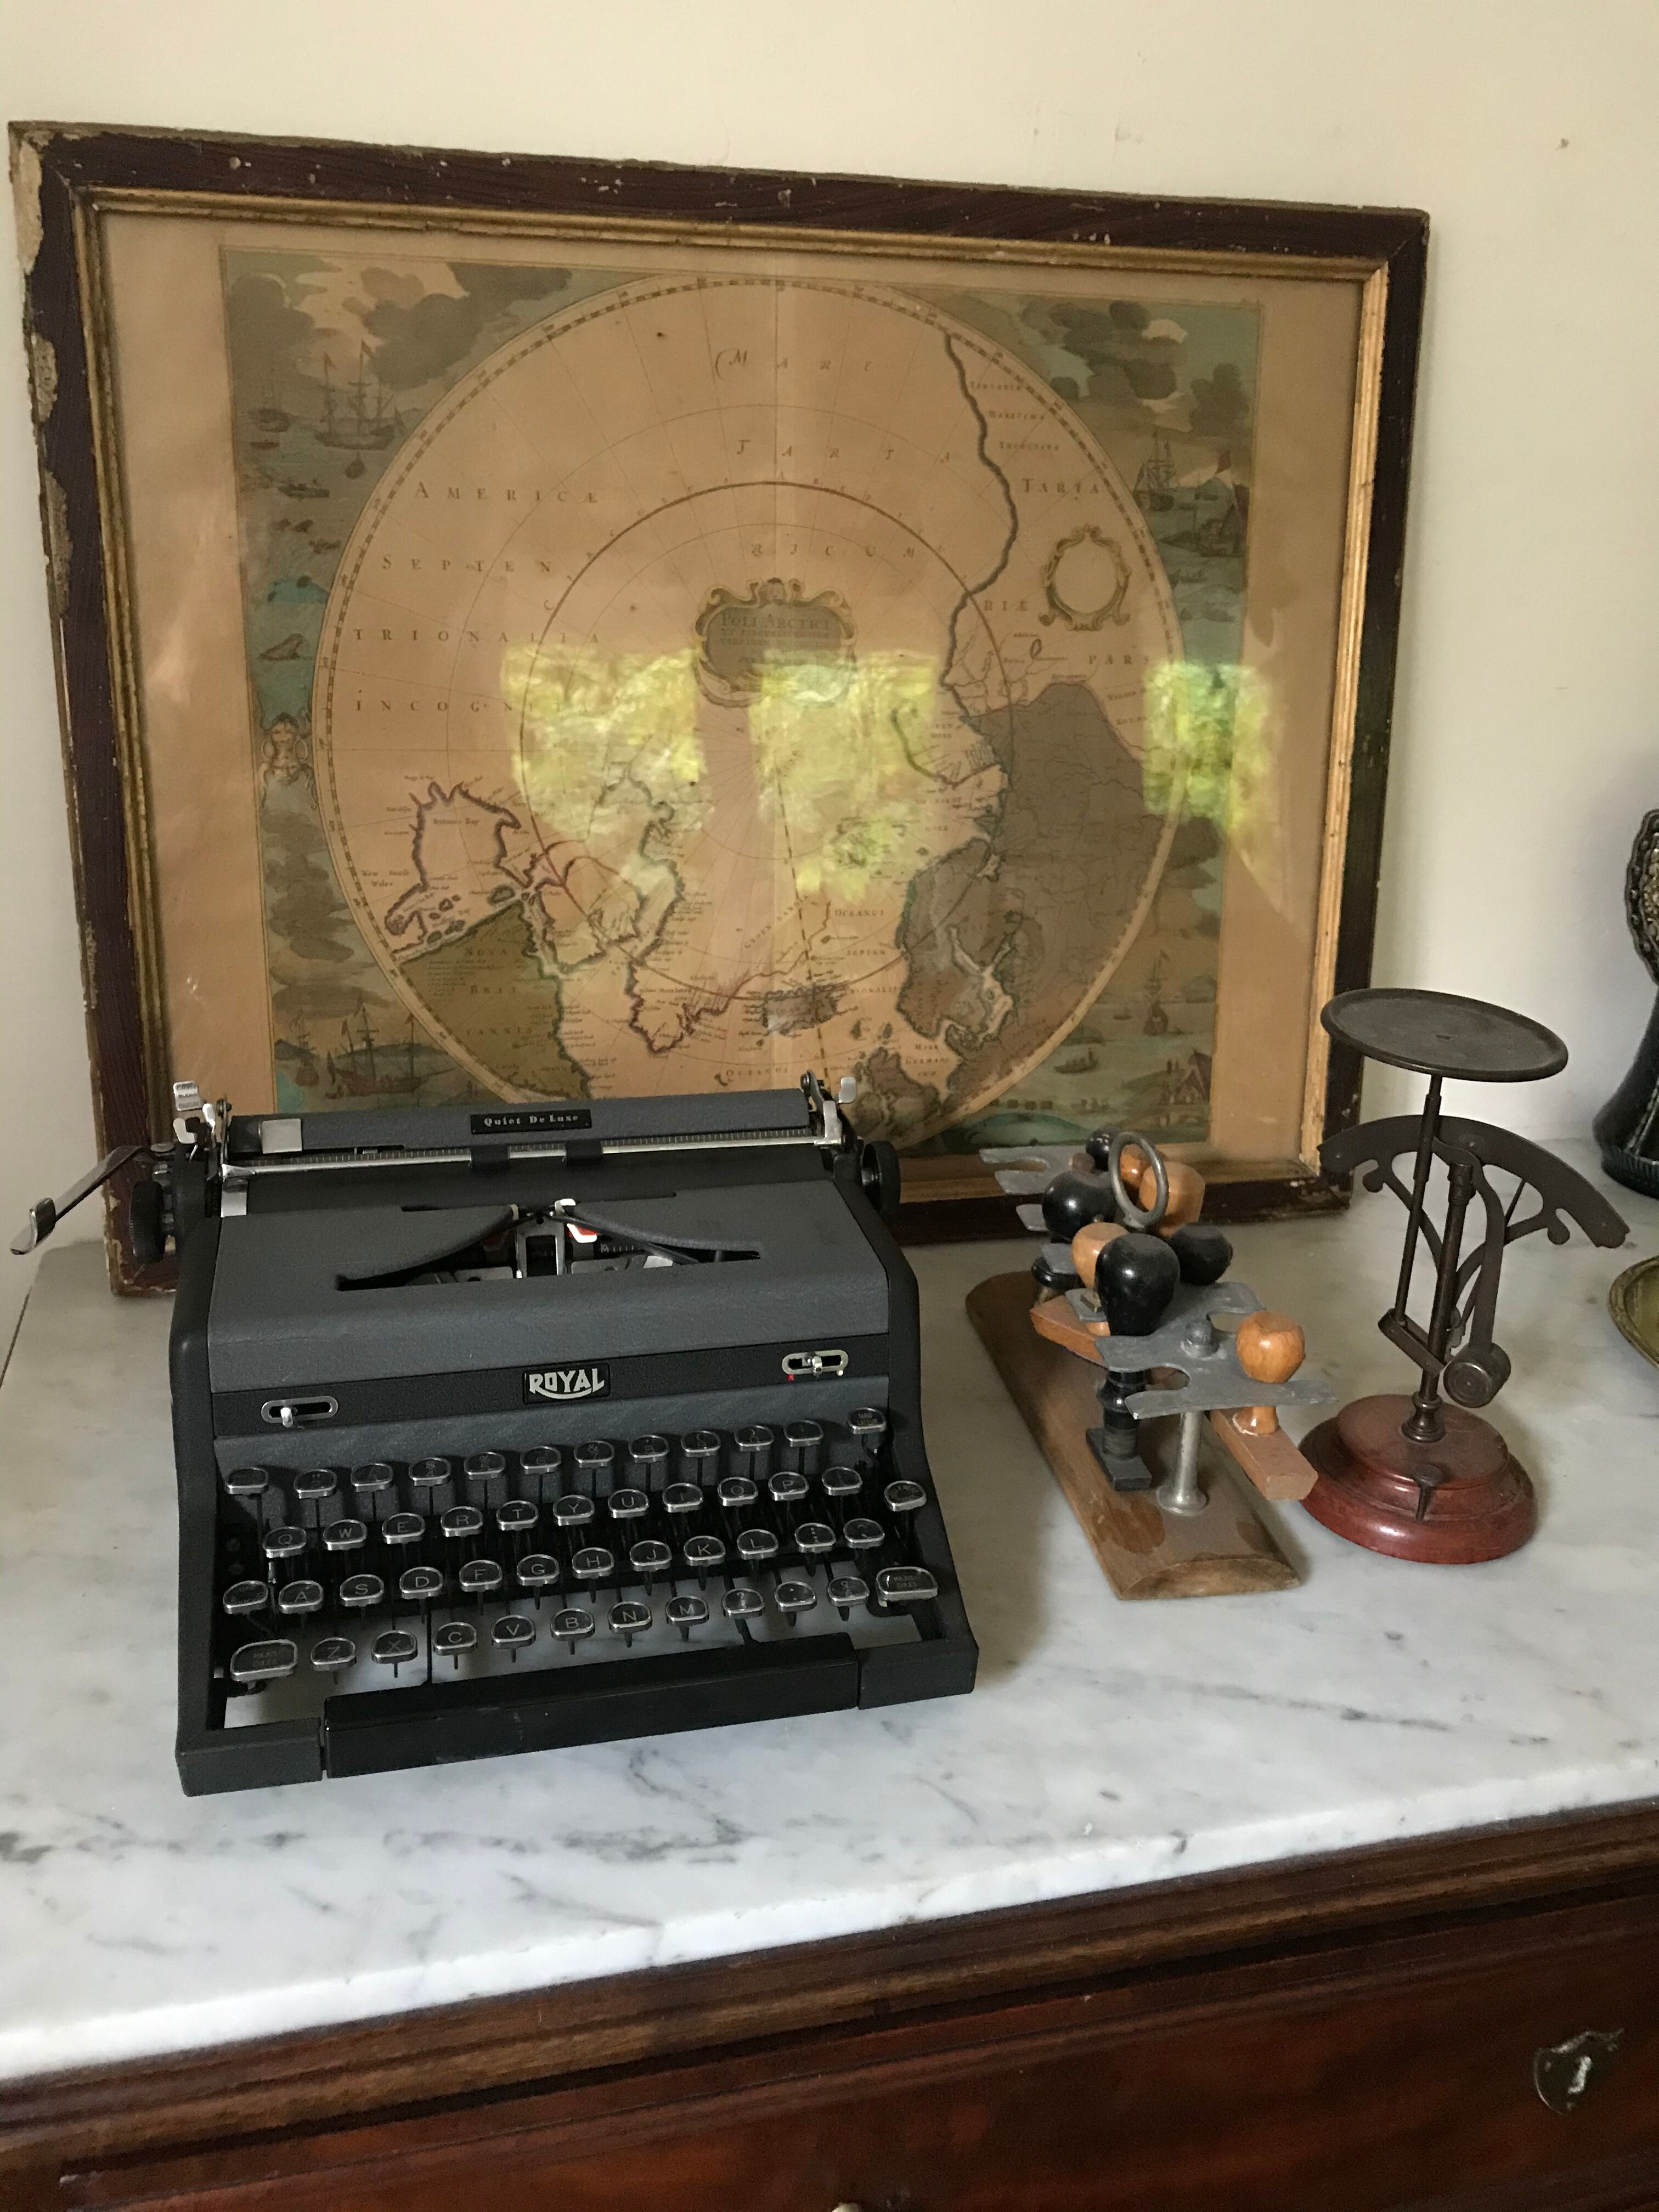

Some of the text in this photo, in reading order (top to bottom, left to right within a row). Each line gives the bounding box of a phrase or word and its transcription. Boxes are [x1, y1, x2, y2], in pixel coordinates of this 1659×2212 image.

[382, 556, 551, 573] SEPTEN
[721, 612, 757, 627] POLI
[834, 908, 884, 917] OCEANUS
[484, 1116, 521, 1127] Quiet
[529, 1368, 605, 1400] ROYAL
[782, 1480, 794, 1489] P
[731, 1485, 744, 1496] O
[622, 1496, 634, 1508] U
[511, 1508, 523, 1519] T
[568, 1503, 579, 1514] Y
[456, 1515, 469, 1526] R
[397, 1521, 410, 1533] E
[338, 1528, 352, 1539] W
[278, 1534, 292, 1545] Q
[749, 1538, 765, 1549] L
[646, 1549, 656, 1560] J
[697, 1544, 712, 1556] K
[586, 1555, 600, 1567] H
[475, 1568, 486, 1581] F
[531, 1564, 545, 1575] G
[415, 1576, 430, 1588] D
[355, 1583, 369, 1595] S
[294, 1591, 308, 1602] A
[679, 1604, 696, 1615] M
[622, 1610, 636, 1622] N
[566, 1617, 579, 1628] B
[506, 1624, 520, 1636] V
[448, 1632, 462, 1644] C
[387, 1640, 401, 1652] X
[326, 1646, 341, 1658] Z
